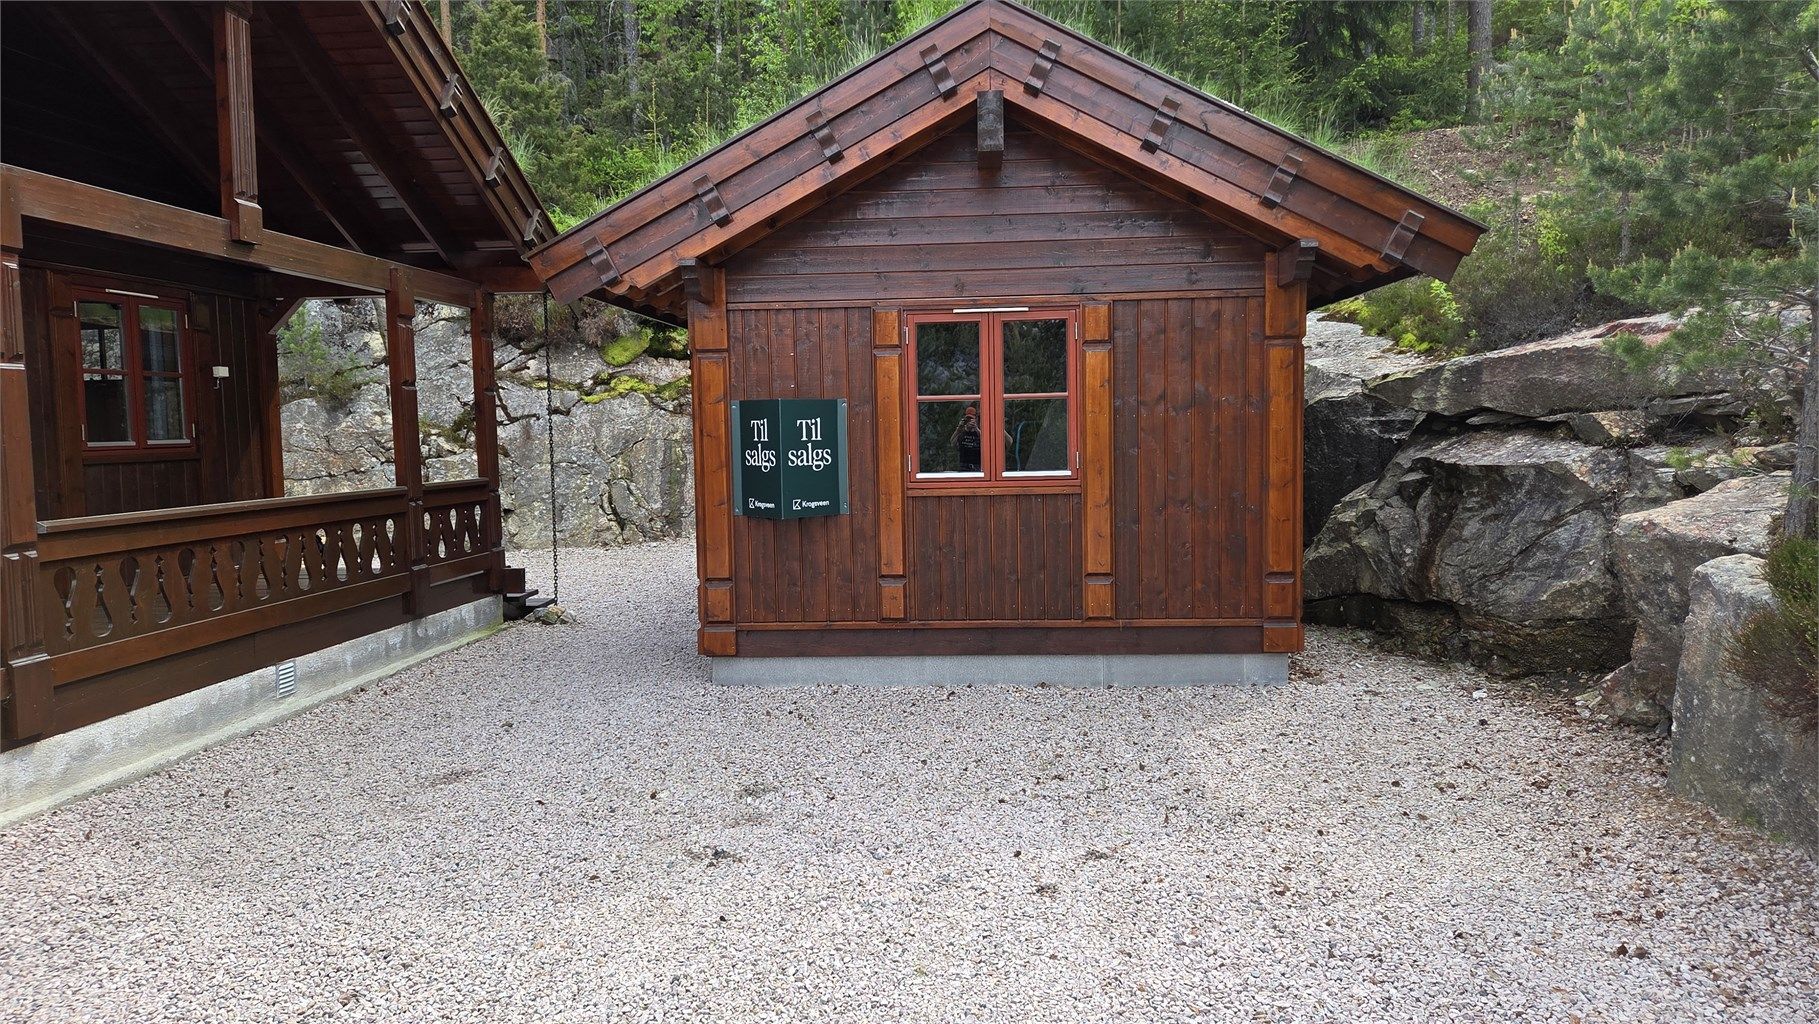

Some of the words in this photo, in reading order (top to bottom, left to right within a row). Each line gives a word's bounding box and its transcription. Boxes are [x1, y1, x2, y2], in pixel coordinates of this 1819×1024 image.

[750, 418, 769, 441] Til
[797, 417, 822, 441] Til
[745, 443, 776, 472] salgs
[788, 442, 832, 472] salgs
[802, 499, 830, 509] Krogsveen
